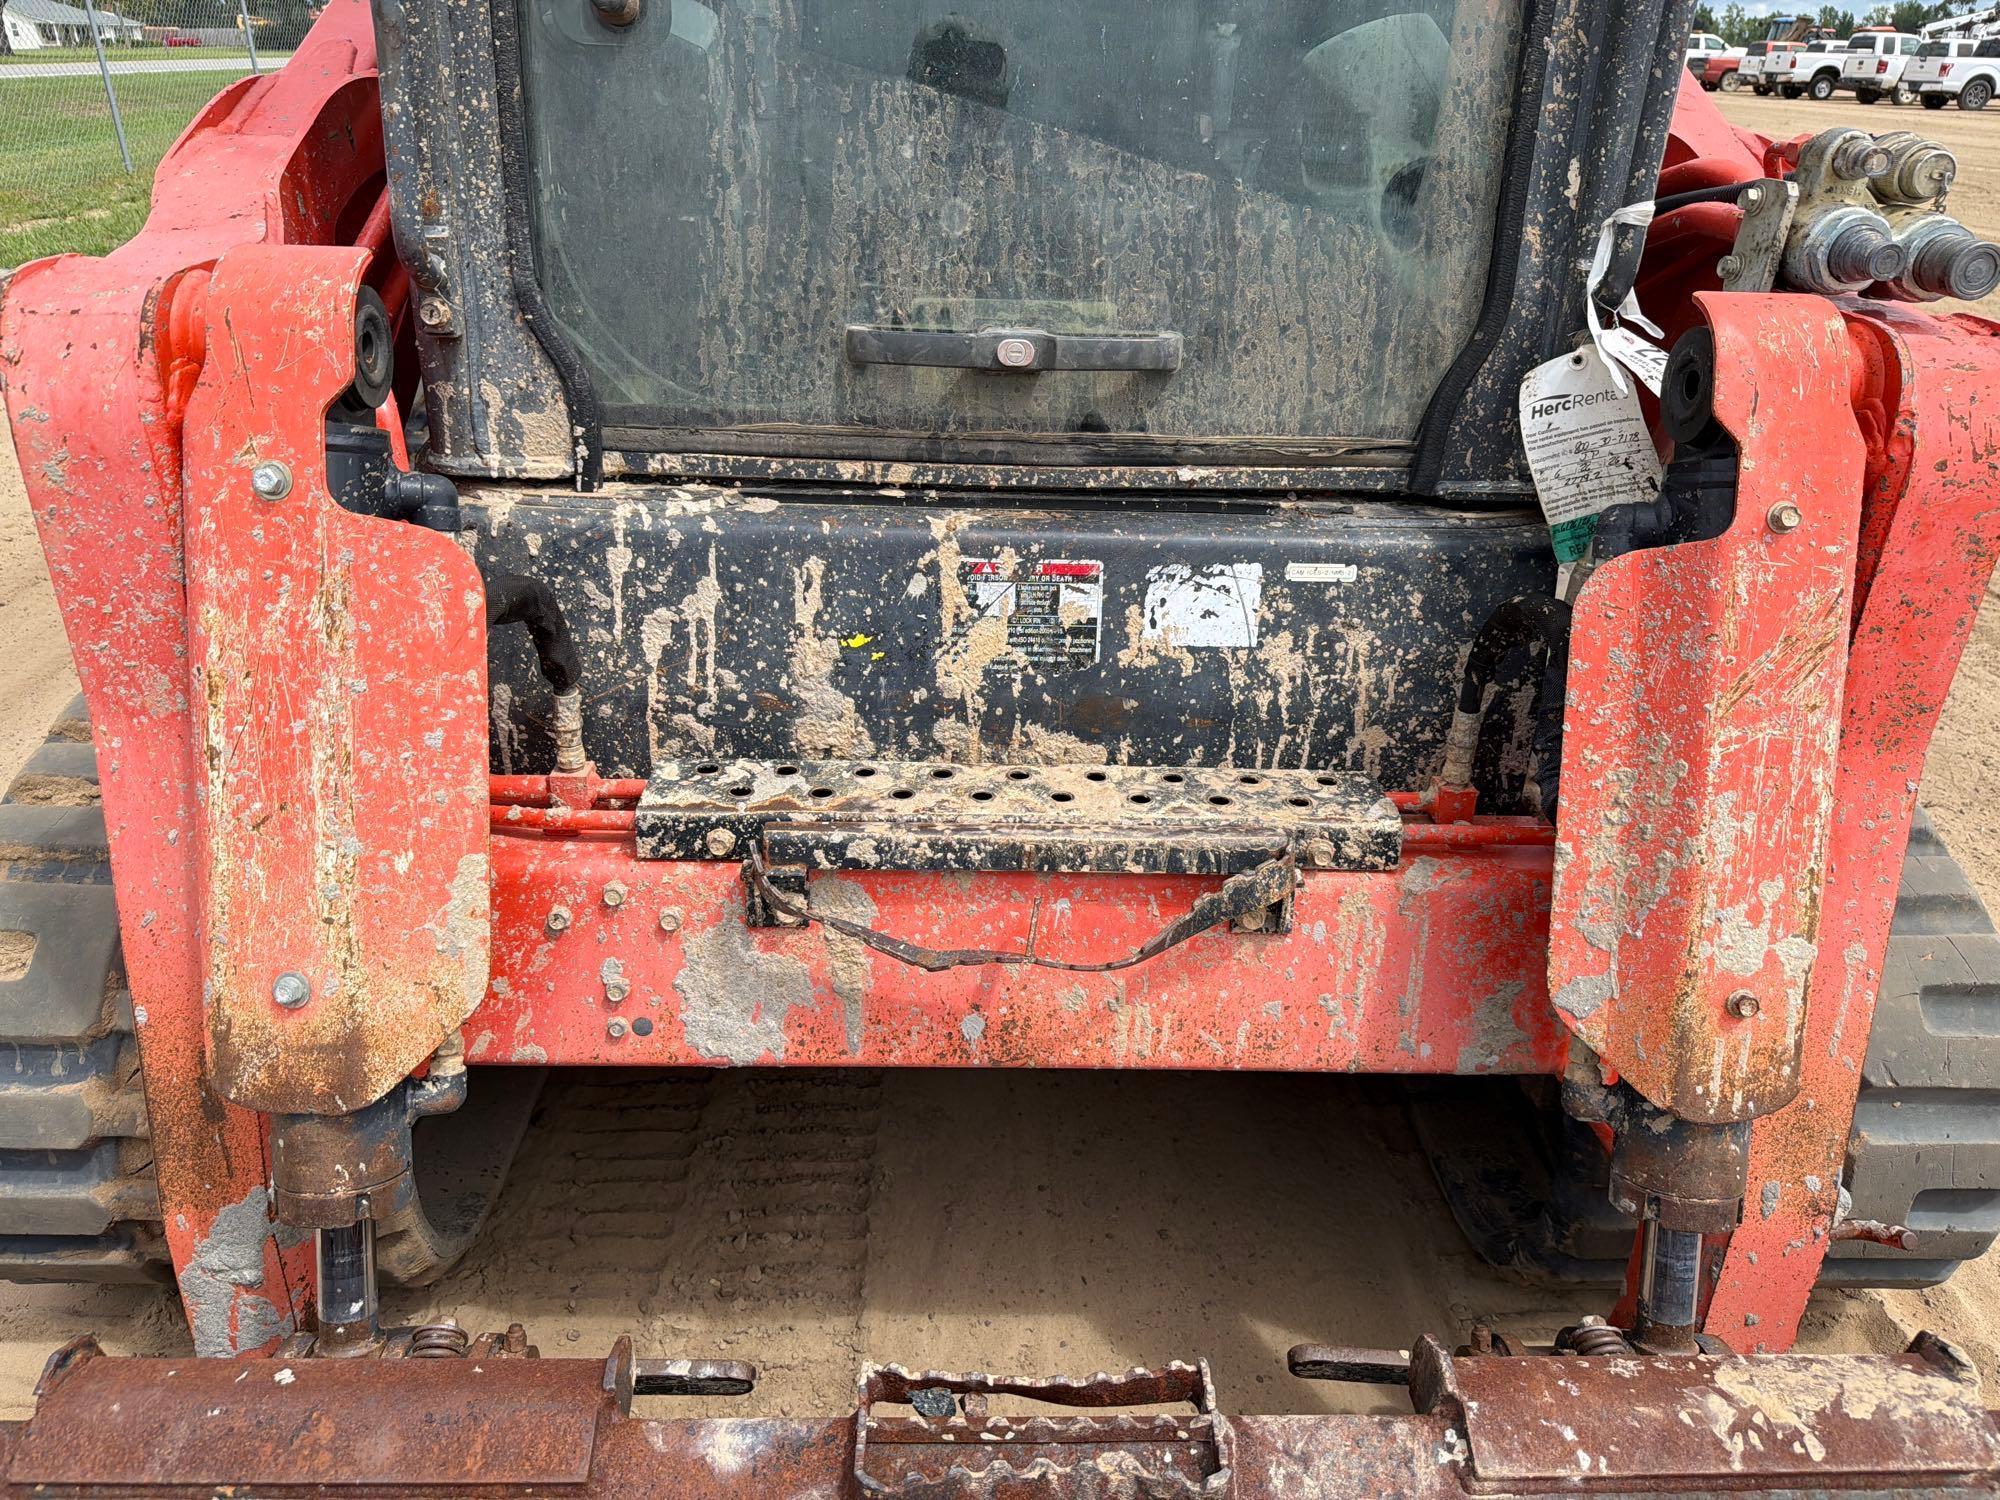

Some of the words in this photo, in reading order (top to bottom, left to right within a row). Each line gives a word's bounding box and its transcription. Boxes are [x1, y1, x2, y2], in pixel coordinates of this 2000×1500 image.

[1530, 389, 1630, 421] HercRenta
[1554, 428, 1580, 438] equipment
[1537, 437, 1573, 450] manufacturer's
[1532, 452, 1561, 464] Equipment
